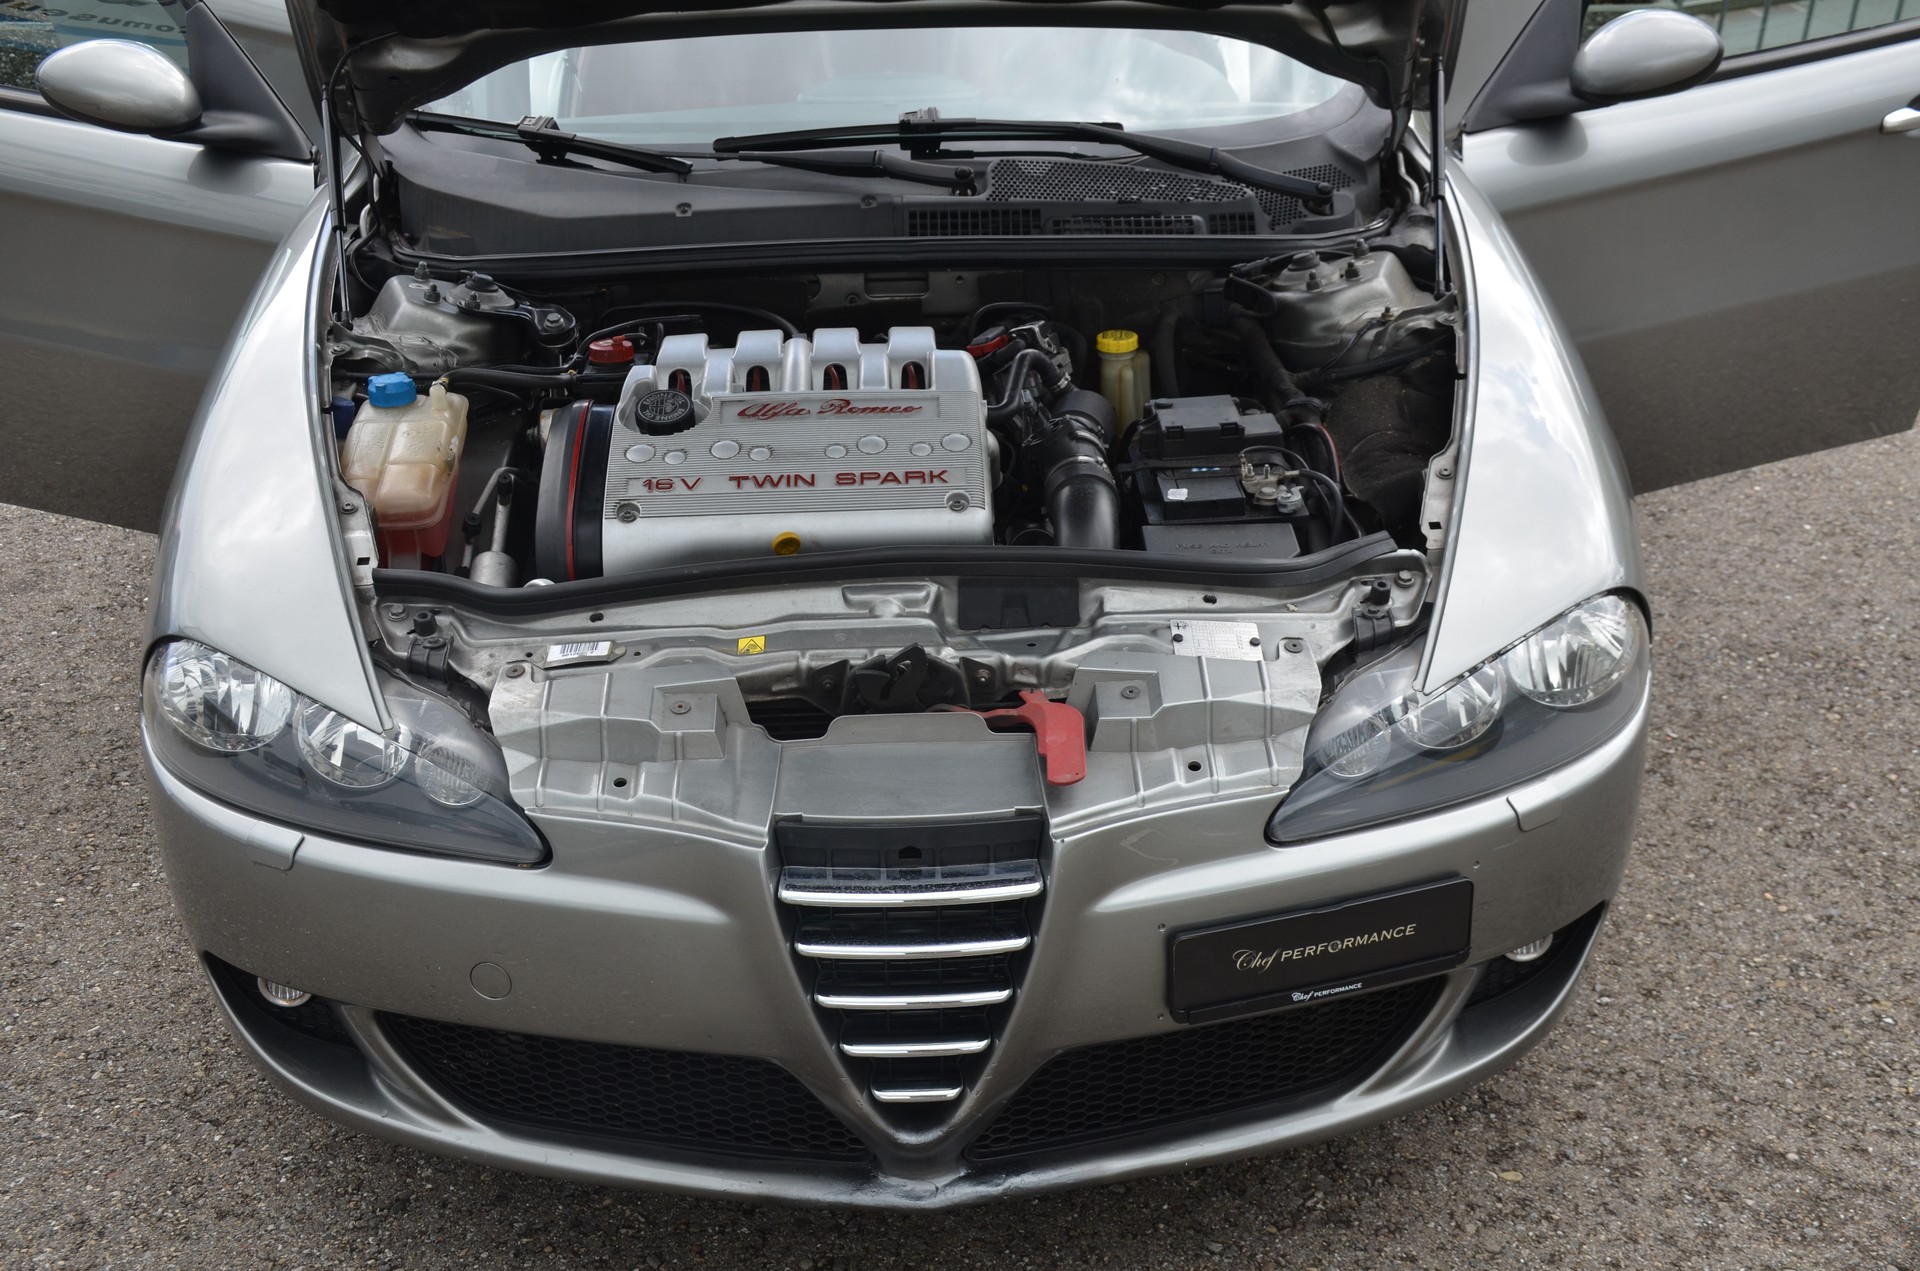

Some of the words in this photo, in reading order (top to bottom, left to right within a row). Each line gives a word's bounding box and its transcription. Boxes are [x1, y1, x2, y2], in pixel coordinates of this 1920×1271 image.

[642, 392, 674, 406] ENGINE
[674, 394, 687, 405] OIL
[737, 401, 811, 420] Alfa
[817, 398, 923, 415] Romeo
[642, 408, 654, 419] OIL
[654, 407, 686, 421] ENGINE
[642, 476, 702, 493] 16V
[729, 472, 816, 489] TWIN
[835, 469, 949, 487] SPARK
[1232, 947, 1283, 974] Chef
[1280, 923, 1417, 962] PERFORMANCE
[1291, 989, 1315, 1002] Chef
[1313, 982, 1363, 998] PERFORMANCE
